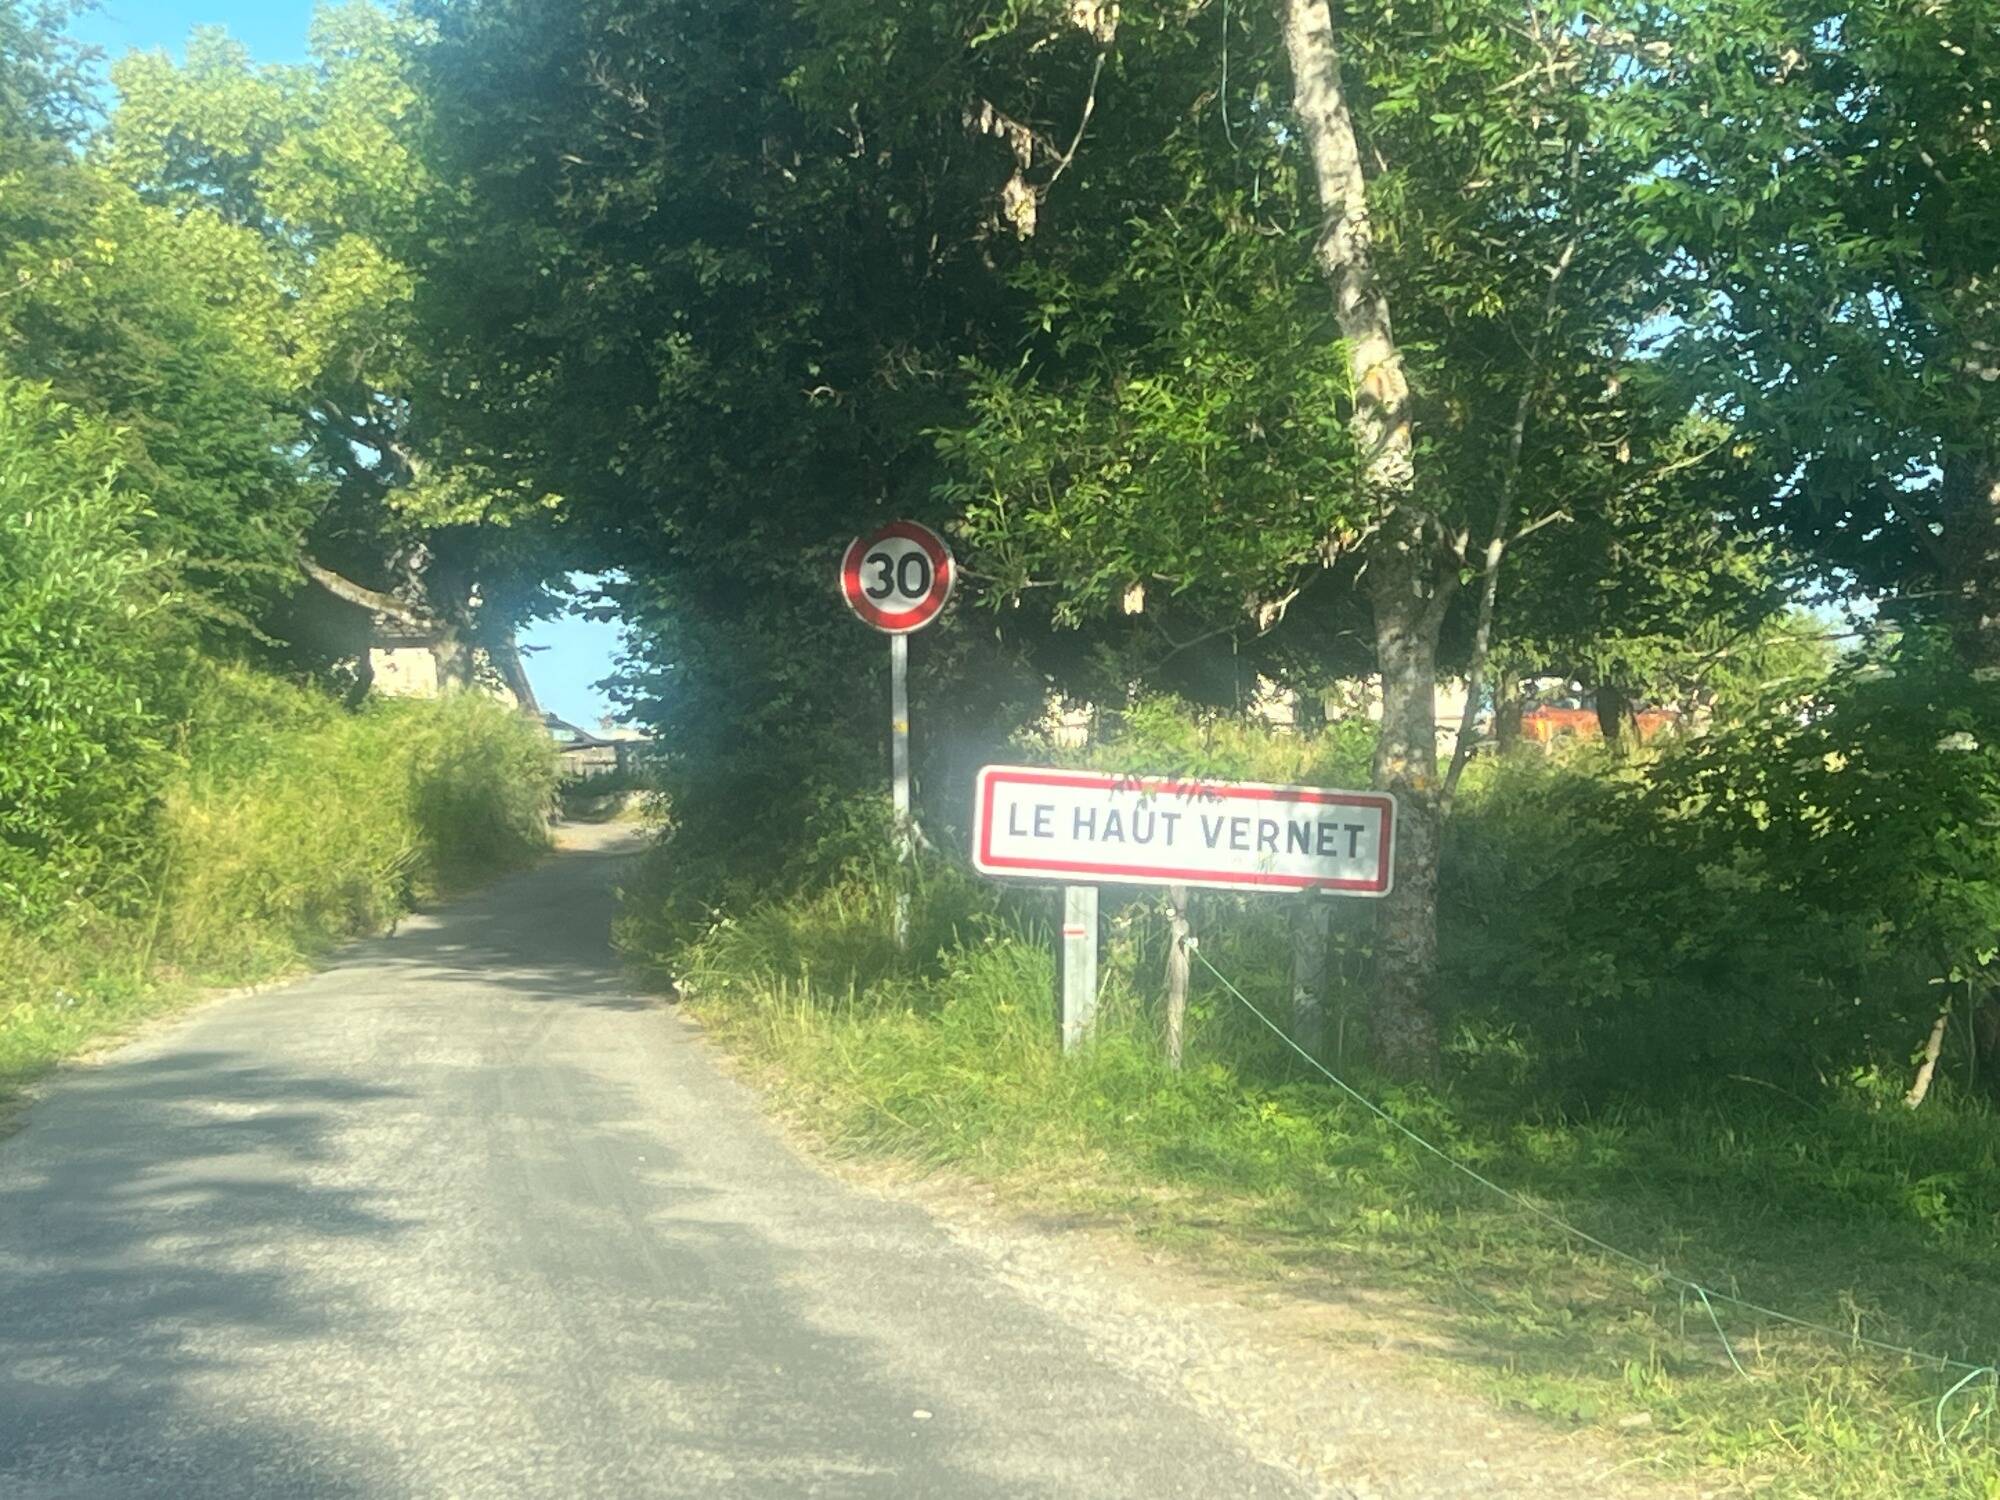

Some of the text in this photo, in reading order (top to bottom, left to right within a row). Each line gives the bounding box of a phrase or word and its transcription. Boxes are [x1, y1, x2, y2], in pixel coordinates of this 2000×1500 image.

[865, 552, 931, 599] 30
[1008, 802, 1055, 838] LE
[1201, 814, 1365, 859] VERNET
